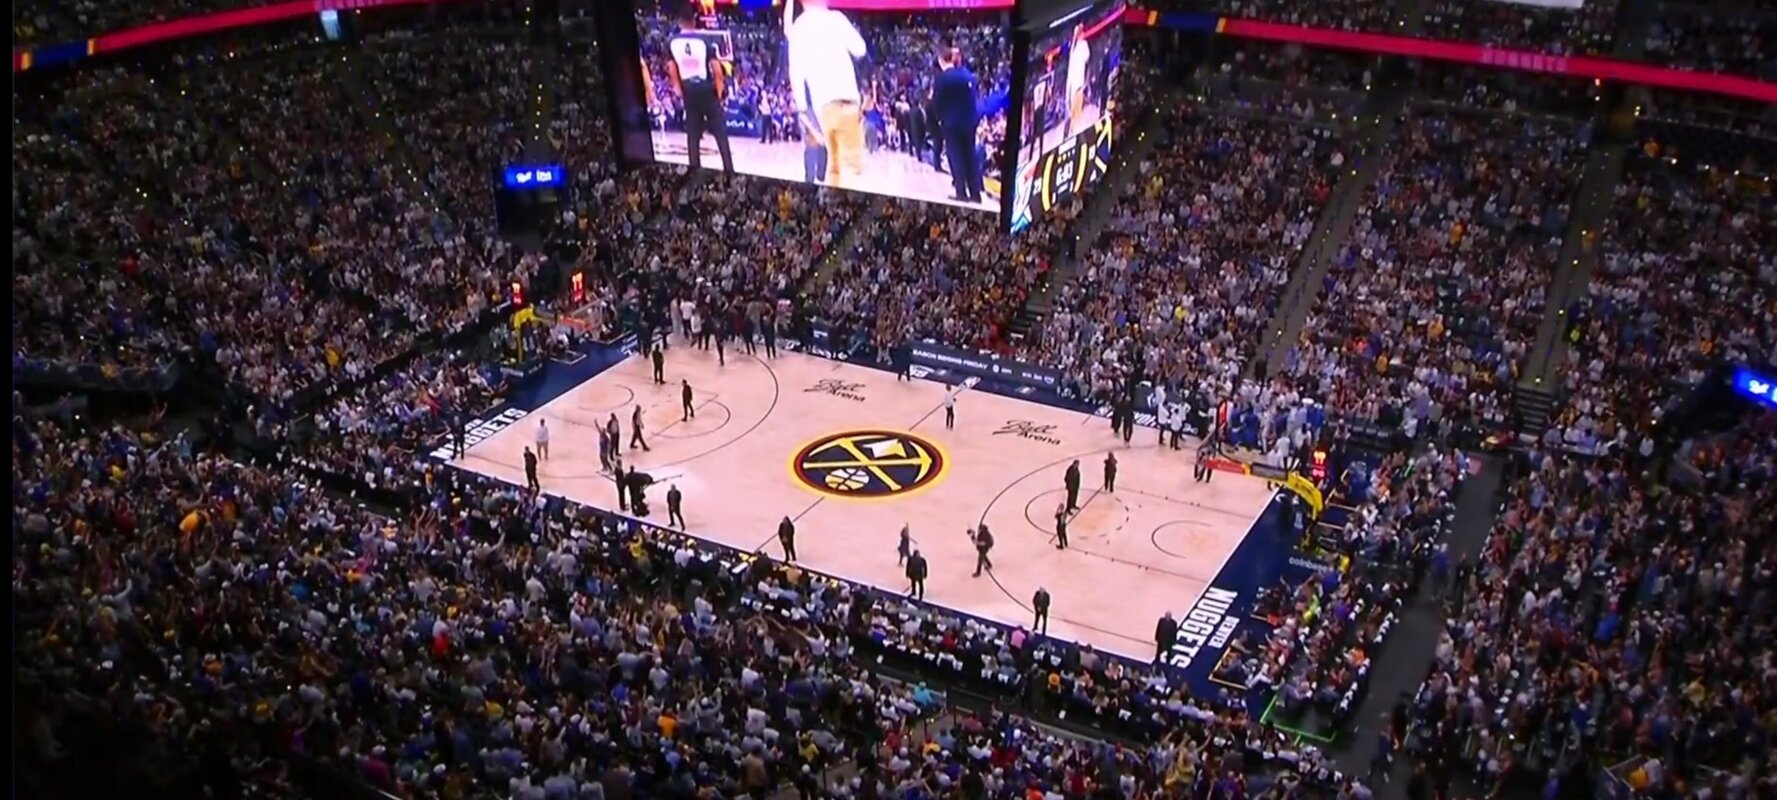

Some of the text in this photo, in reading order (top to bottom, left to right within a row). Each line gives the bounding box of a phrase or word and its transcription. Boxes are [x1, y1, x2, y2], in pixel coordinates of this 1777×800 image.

[684, 42, 692, 56] 4
[829, 388, 866, 402] Arena
[1017, 431, 1061, 446] Arena
[1170, 586, 1238, 668] NUGGETS
